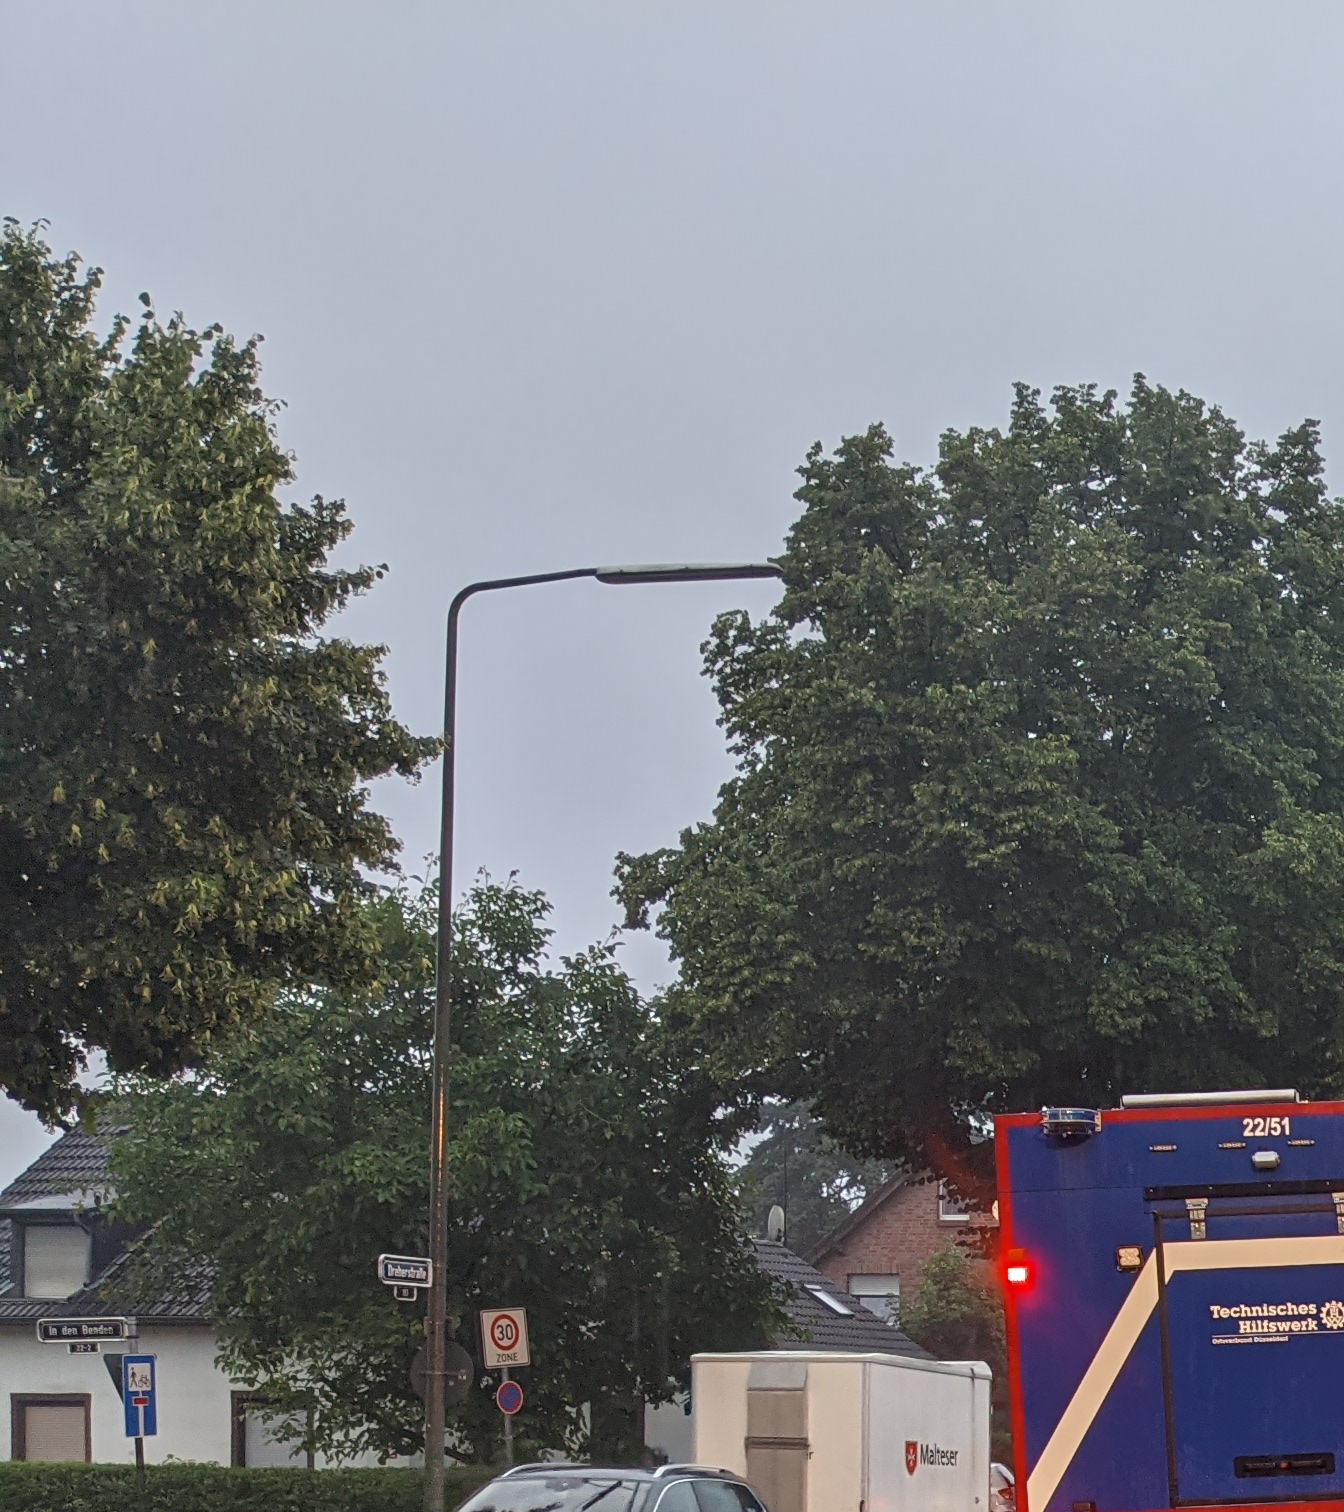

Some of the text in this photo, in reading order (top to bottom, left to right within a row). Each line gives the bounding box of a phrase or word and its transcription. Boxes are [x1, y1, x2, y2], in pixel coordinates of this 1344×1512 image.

[1242, 1117, 1291, 1137] 22/51
[1210, 1302, 1318, 1319] Technisches
[48, 1325, 57, 1336] In
[62, 1325, 78, 1336] den
[496, 1324, 514, 1341] 30
[1238, 1317, 1319, 1334] Hilfswerk
[496, 1352, 519, 1363] ZONE
[919, 1443, 959, 1467] Malteser
